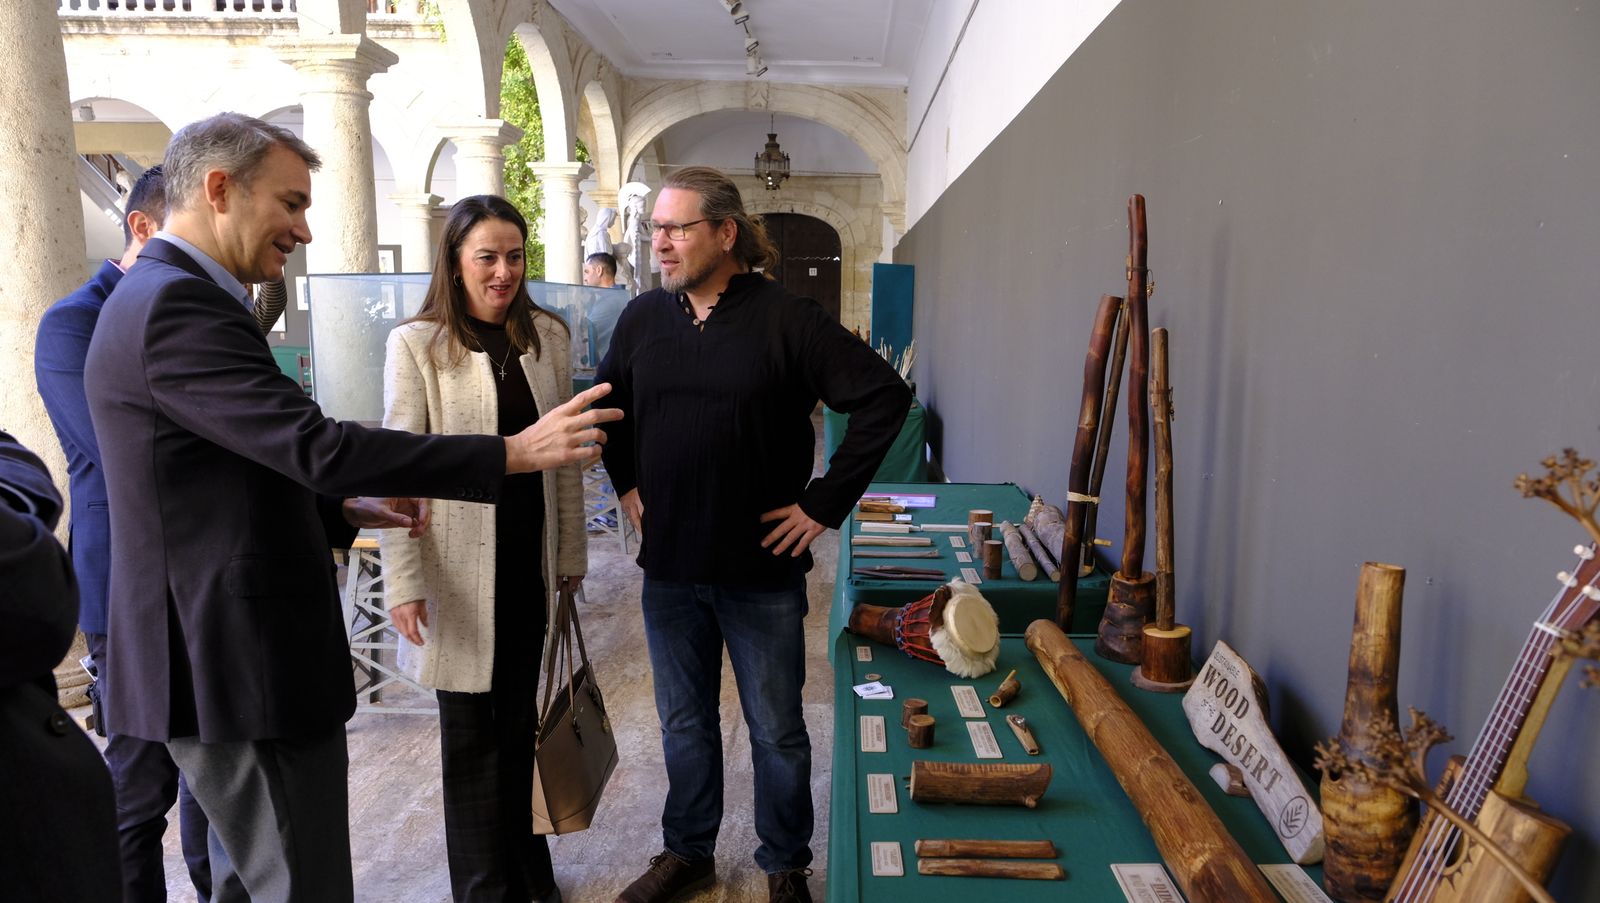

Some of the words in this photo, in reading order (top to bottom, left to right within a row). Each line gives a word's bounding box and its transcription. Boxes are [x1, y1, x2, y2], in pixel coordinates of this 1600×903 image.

[1203, 664, 1250, 720] WOOD
[1214, 651, 1240, 679] SUSTAINABLE
[1211, 711, 1284, 794] DESERT
